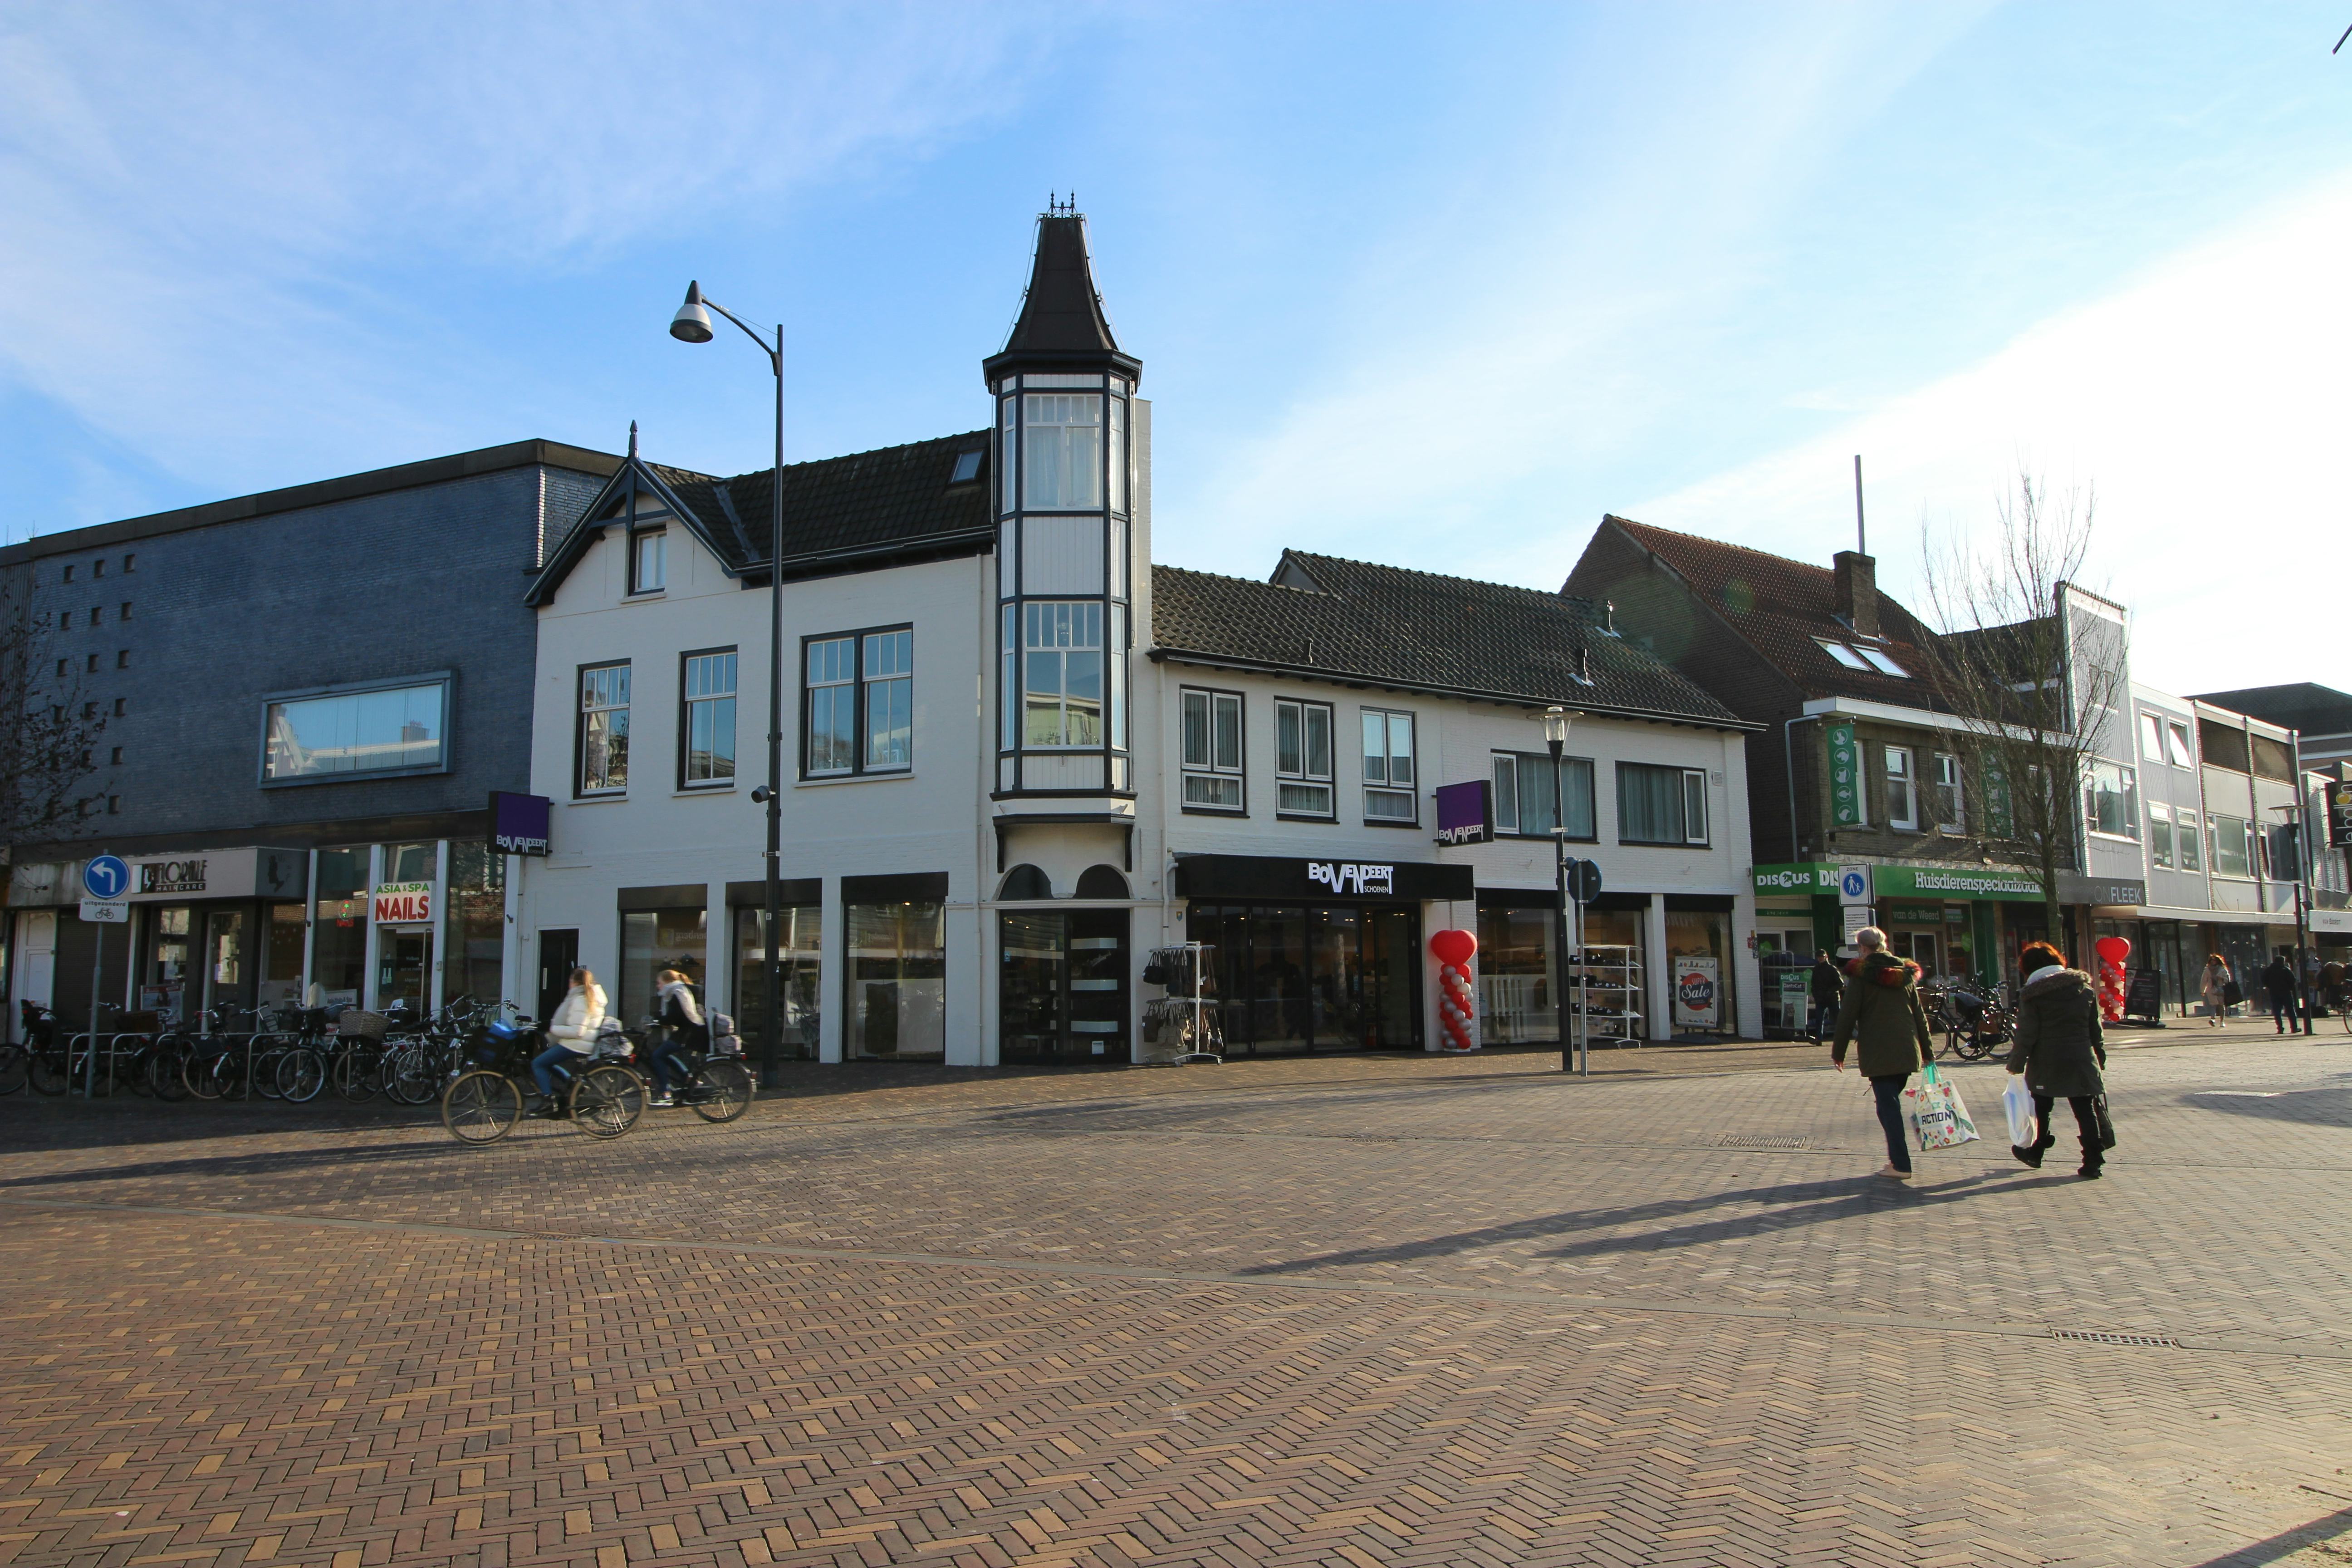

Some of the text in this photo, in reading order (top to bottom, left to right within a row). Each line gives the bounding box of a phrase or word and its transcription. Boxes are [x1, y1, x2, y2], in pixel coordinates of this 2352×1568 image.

[1439, 824, 1484, 843] BOVENDEERT
[497, 835, 547, 855] BOVENDEERT
[1308, 863, 1393, 894] BOVENDEERT
[1757, 871, 1810, 887] DISCUS
[1818, 870, 1839, 887] DIS
[1915, 872, 2041, 894] Huisdierenspeciaalzaak
[376, 884, 401, 894] ASIA
[408, 882, 429, 892] SPA
[375, 896, 429, 921] NAILS
[1893, 911, 1906, 919] van
[1907, 910, 1916, 919] de
[1918, 910, 1940, 920] Weerd
[1691, 977, 1705, 985] SUPER
[1681, 984, 1710, 999] Sale
[1921, 1111, 1951, 1125] ACTION
